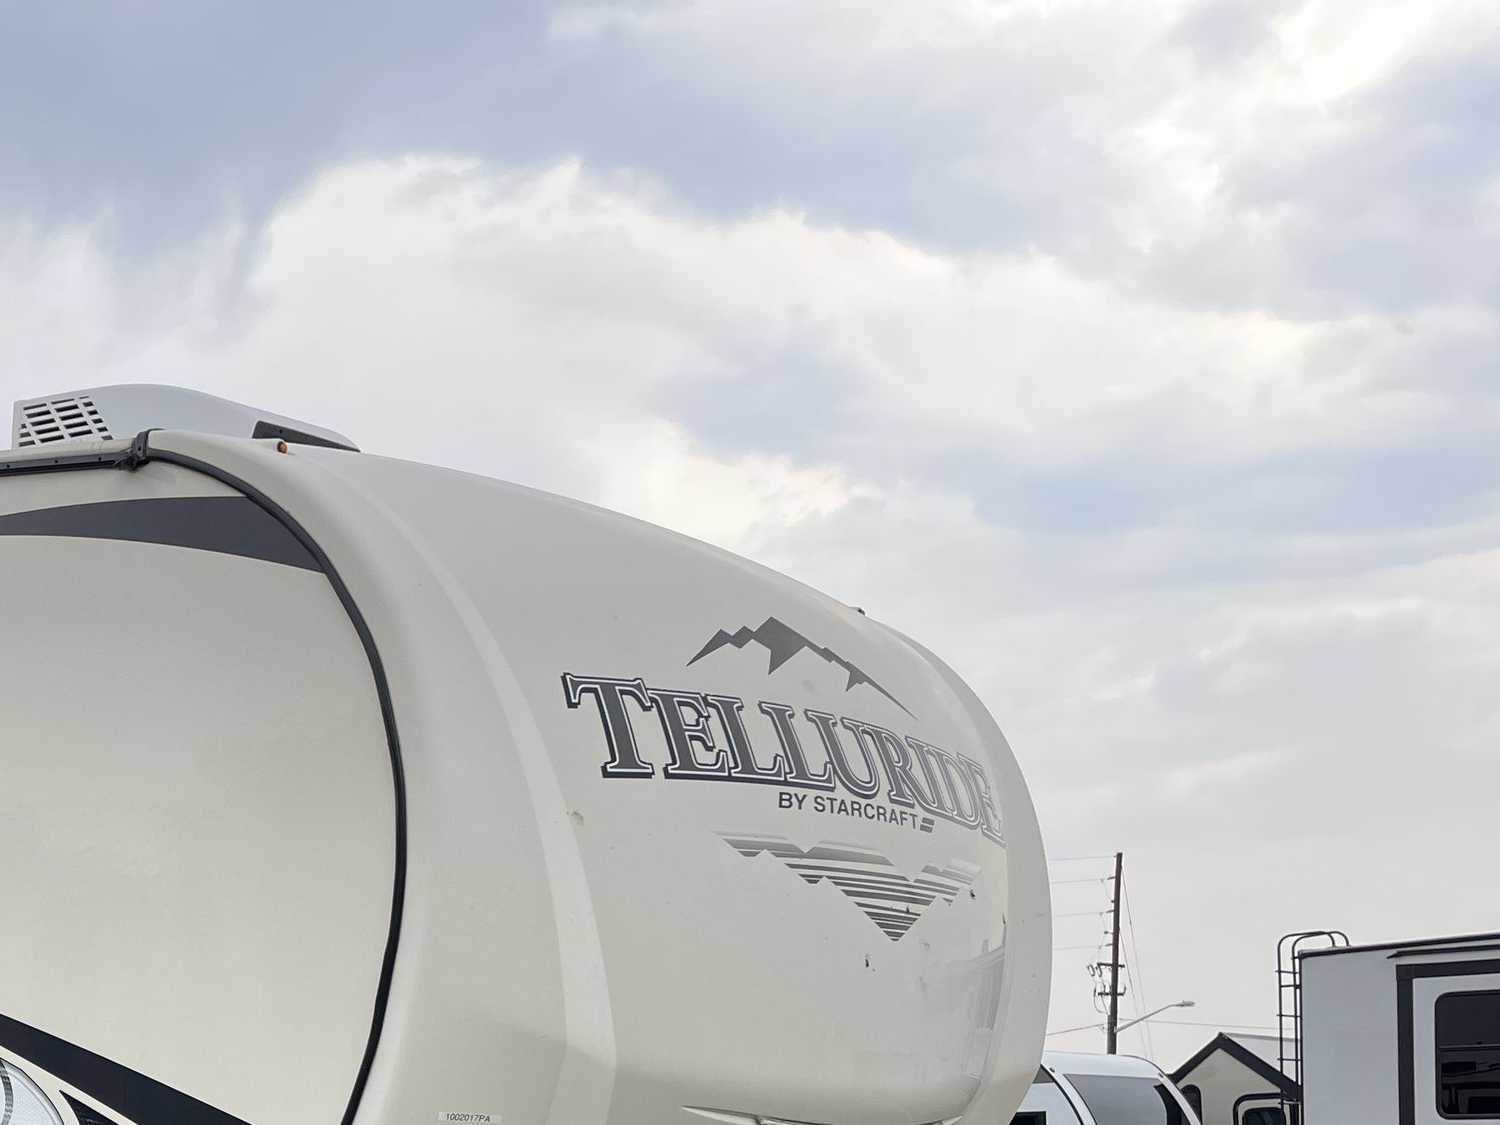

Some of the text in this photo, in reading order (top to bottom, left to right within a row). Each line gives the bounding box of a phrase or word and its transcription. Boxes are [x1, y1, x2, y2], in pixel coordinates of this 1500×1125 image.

[561, 672, 1006, 847] TELLURIDE
[778, 791, 918, 830] BY STARCRAFT
[446, 1113, 490, 1122] 1002017PA
